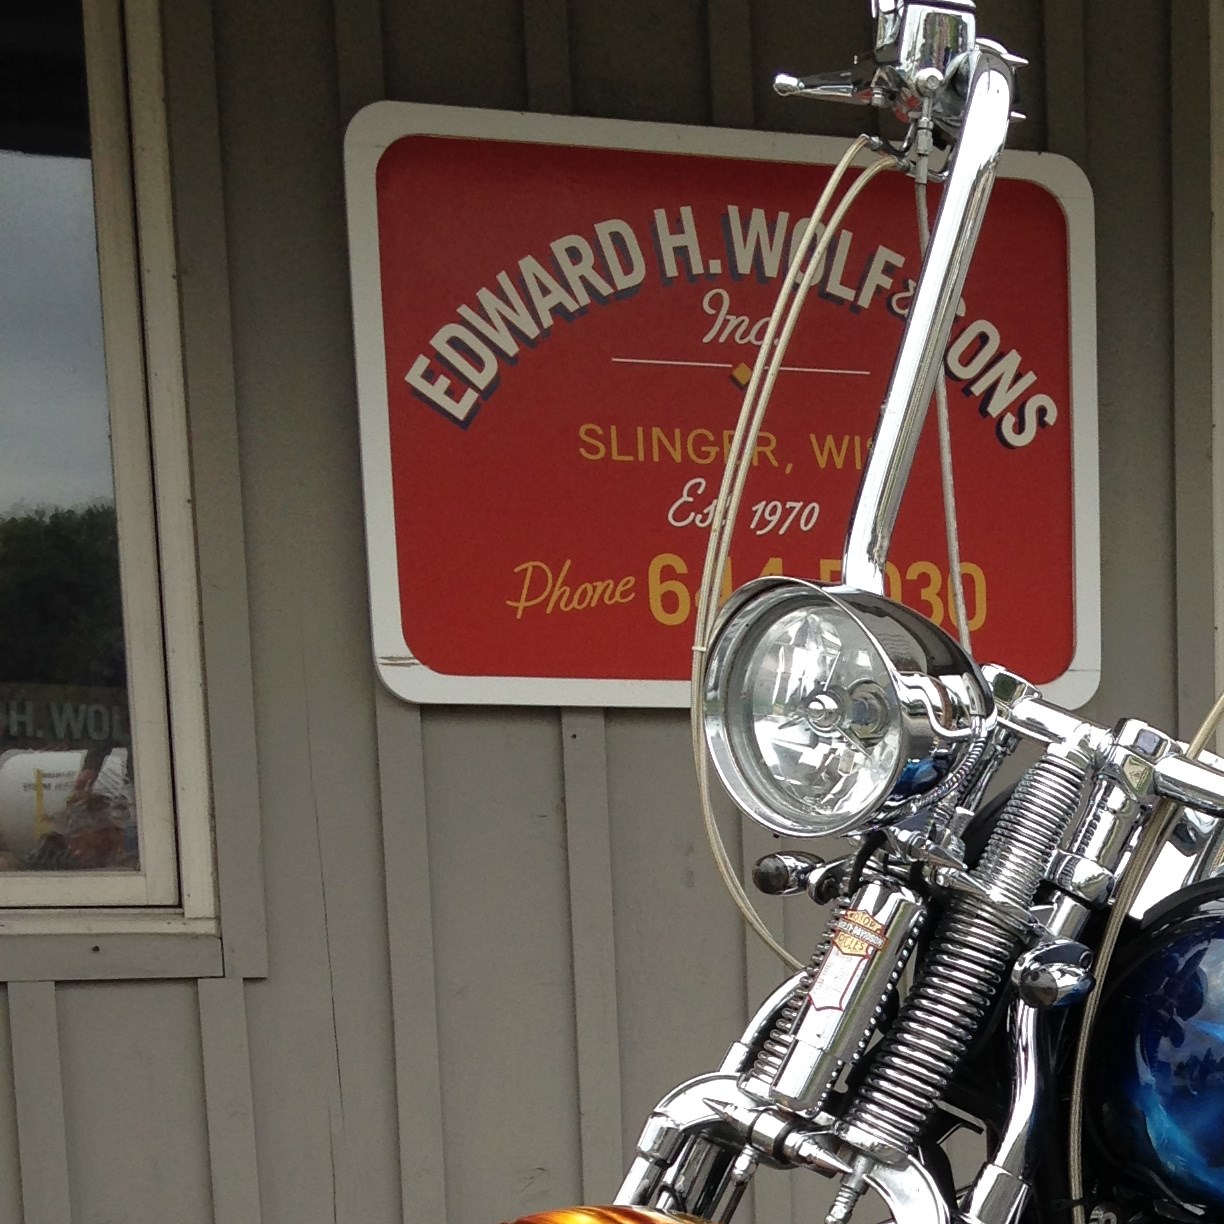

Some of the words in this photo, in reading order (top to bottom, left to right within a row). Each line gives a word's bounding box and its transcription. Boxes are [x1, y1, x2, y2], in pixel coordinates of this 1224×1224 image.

[404, 218, 647, 422] EDWARD
[653, 205, 722, 278] H.
[727, 204, 906, 309] WOLF
[946, 297, 1058, 448] ONS
[810, 432, 874, 471] WI
[667, 477, 733, 528] Es
[750, 500, 820, 536] 1970
[506, 558, 636, 620] Phone
